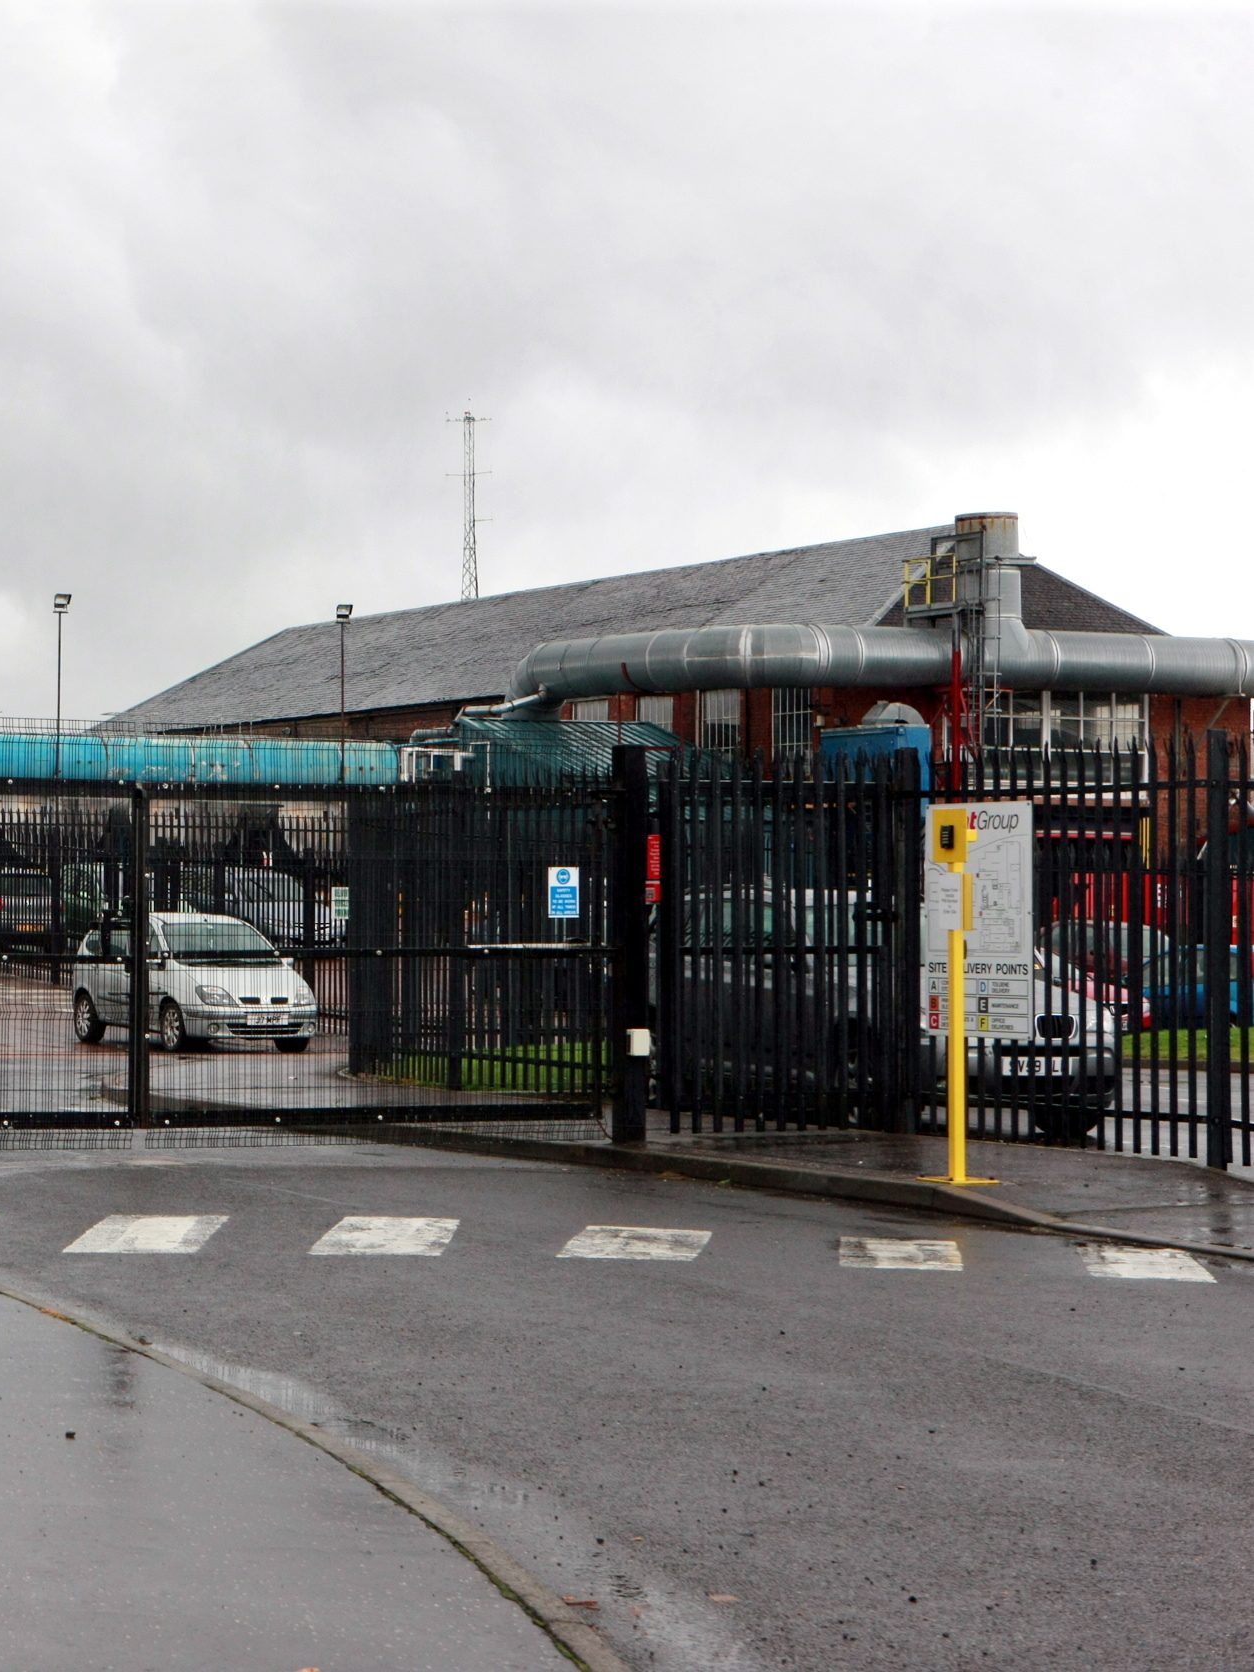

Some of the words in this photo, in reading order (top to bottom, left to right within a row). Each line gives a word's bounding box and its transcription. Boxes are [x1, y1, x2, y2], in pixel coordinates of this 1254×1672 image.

[929, 962, 948, 973] SITE
[963, 963, 992, 974] LIVERY
[996, 964, 1028, 975] POINTS
[931, 981, 937, 991] A
[981, 982, 986, 992] D
[931, 998, 936, 1009] B
[981, 1000, 986, 1009] E
[931, 1016, 937, 1026] C
[981, 1018, 986, 1028] F
